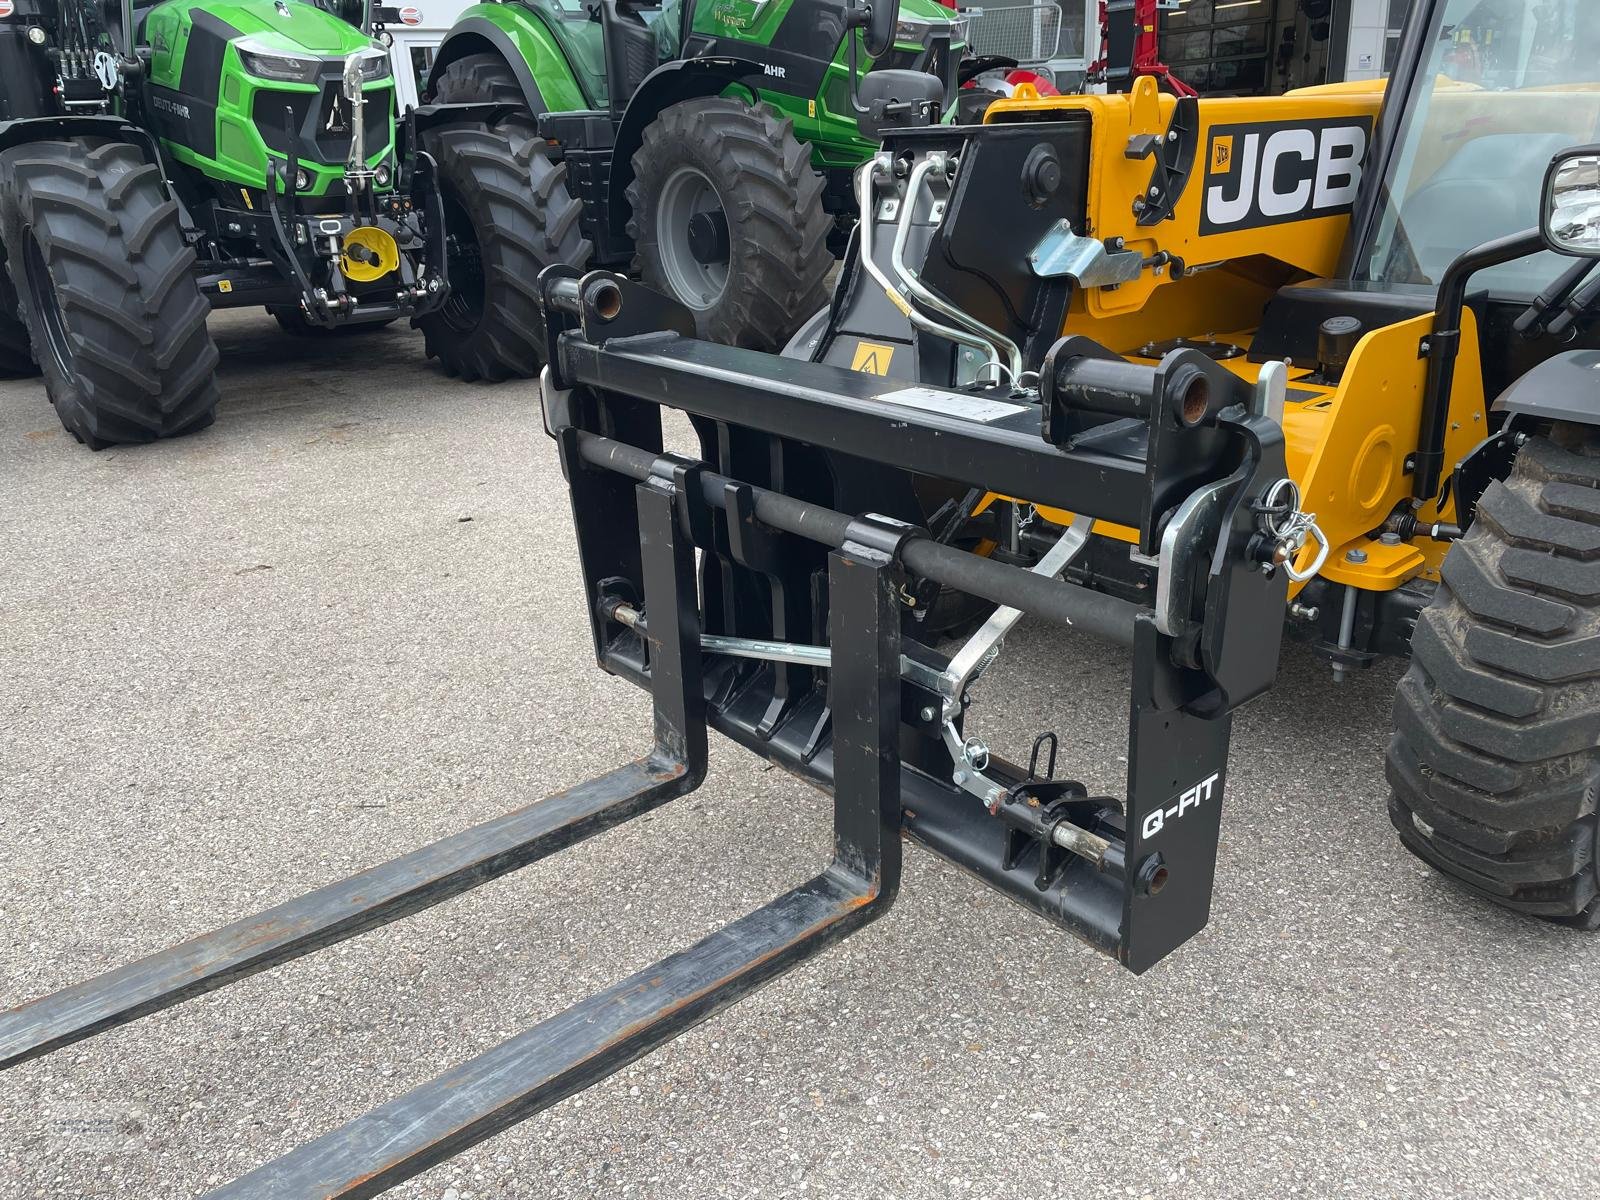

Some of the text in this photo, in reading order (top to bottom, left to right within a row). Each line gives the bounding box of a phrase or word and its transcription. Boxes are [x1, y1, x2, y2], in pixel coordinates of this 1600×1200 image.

[758, 62, 786, 78] AHR
[1206, 126, 1366, 225] JCB
[1142, 772, 1219, 840] Q-FIT
